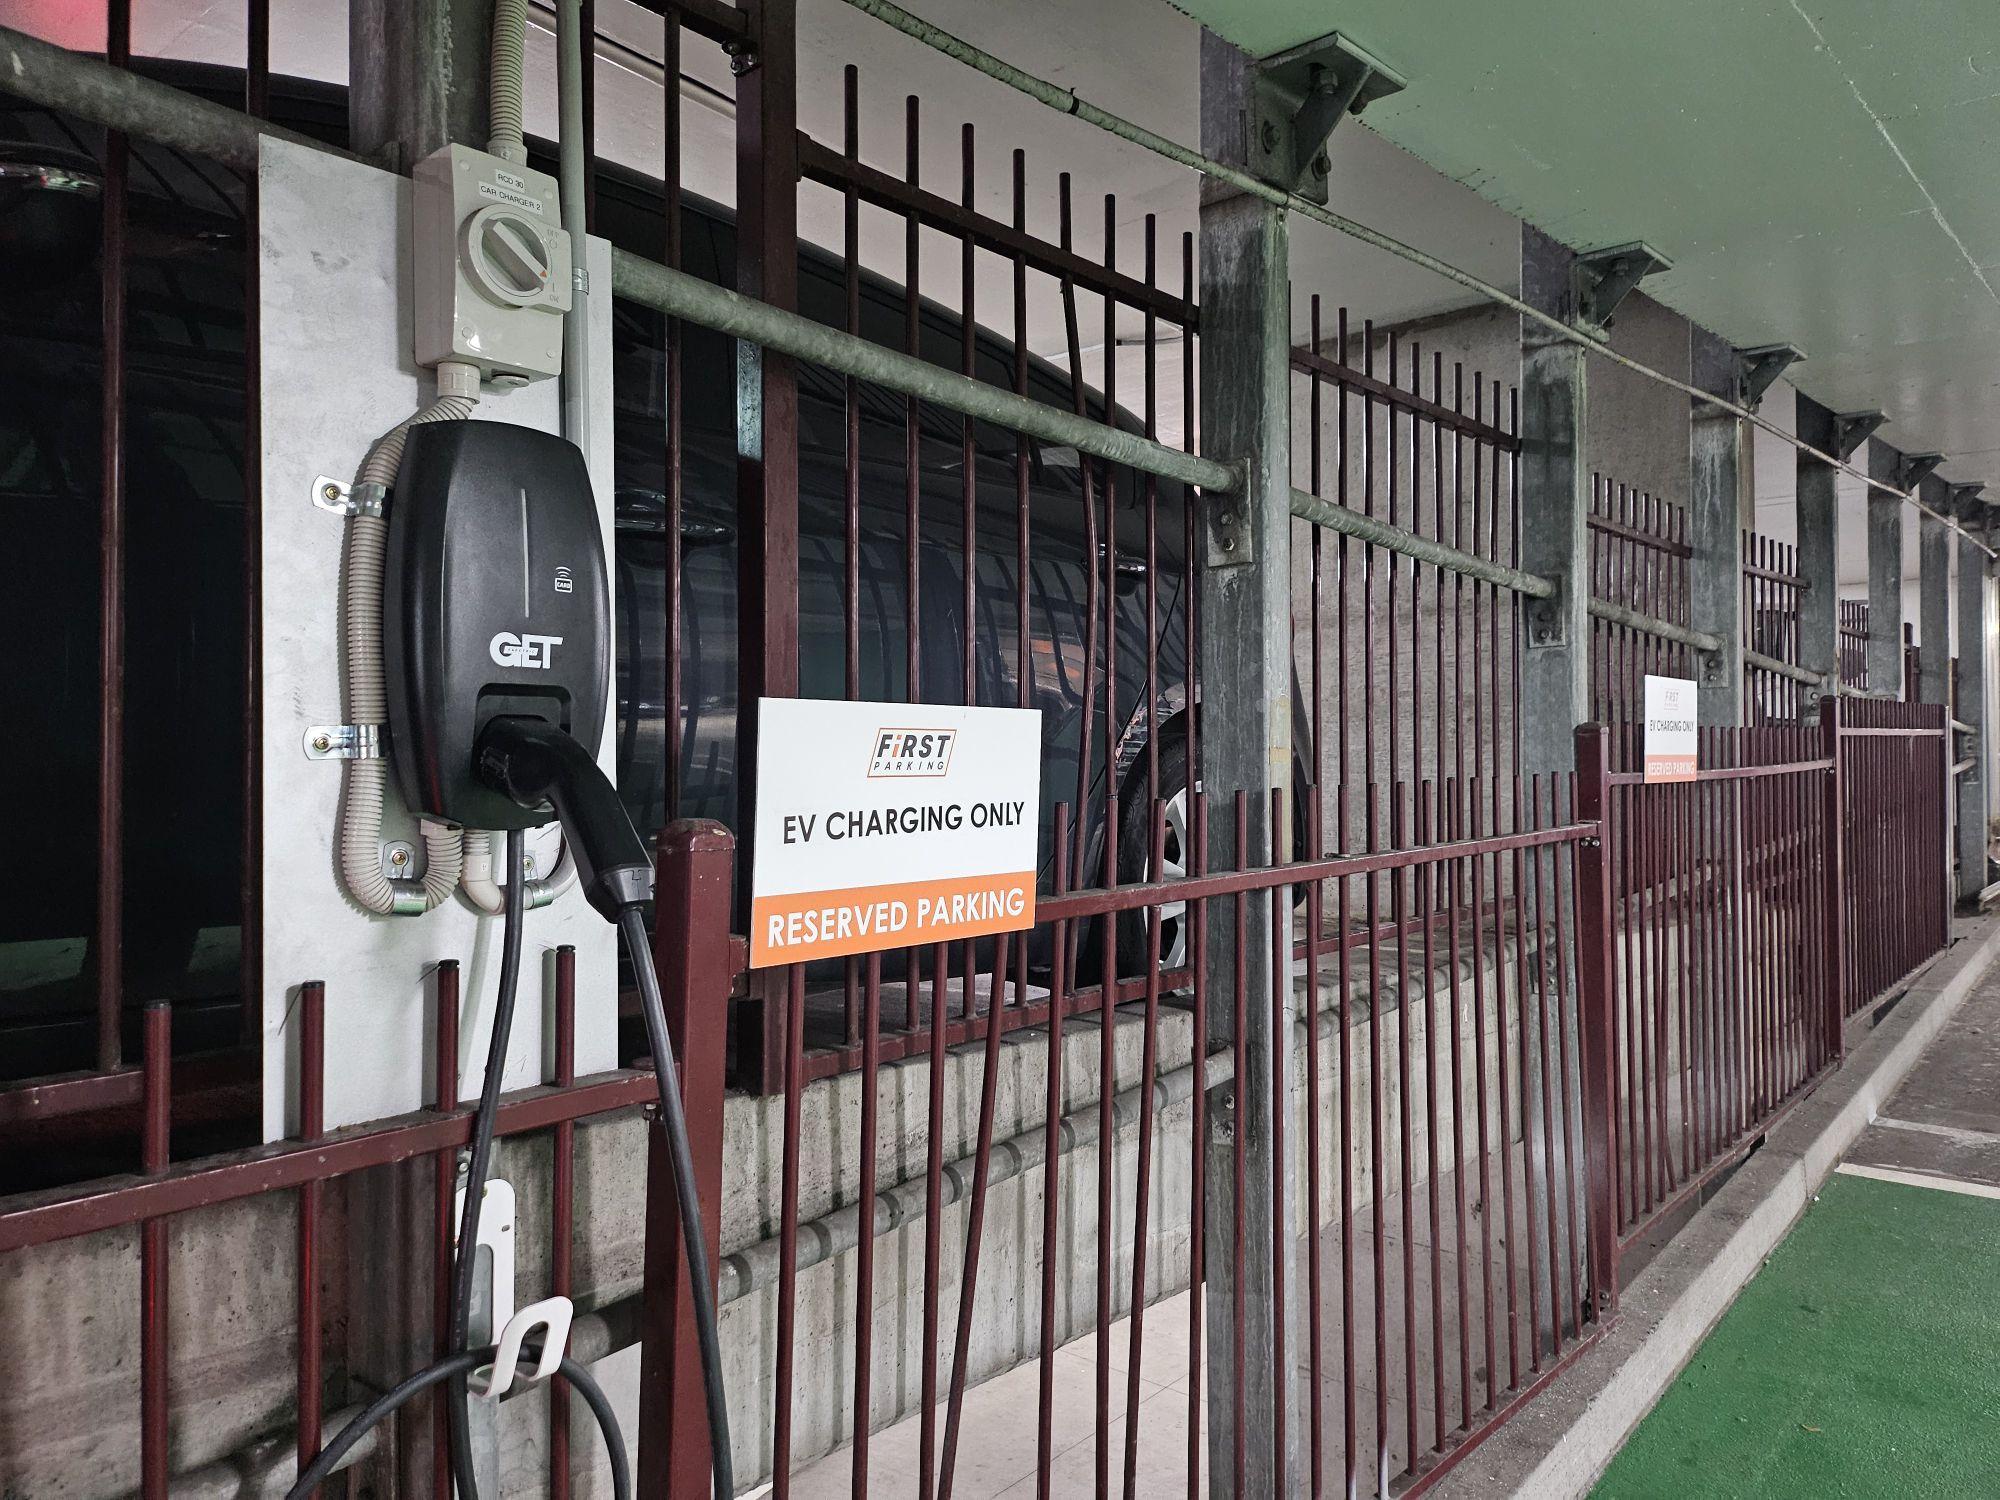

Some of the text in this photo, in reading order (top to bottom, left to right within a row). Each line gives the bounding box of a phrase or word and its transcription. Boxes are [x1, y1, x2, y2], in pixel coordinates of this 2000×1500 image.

[497, 173, 524, 189] RCD 30
[480, 185, 541, 211] CAR CHARGER 2
[489, 631, 564, 669] GET
[1650, 719, 1694, 732] EV CHARGING ONLY
[873, 761, 944, 771] PARKING
[1648, 761, 1694, 776] RESERVED PARKING
[783, 801, 1025, 844] EV CHARGING ONLY
[767, 887, 1025, 948] RESERVED PARKING
